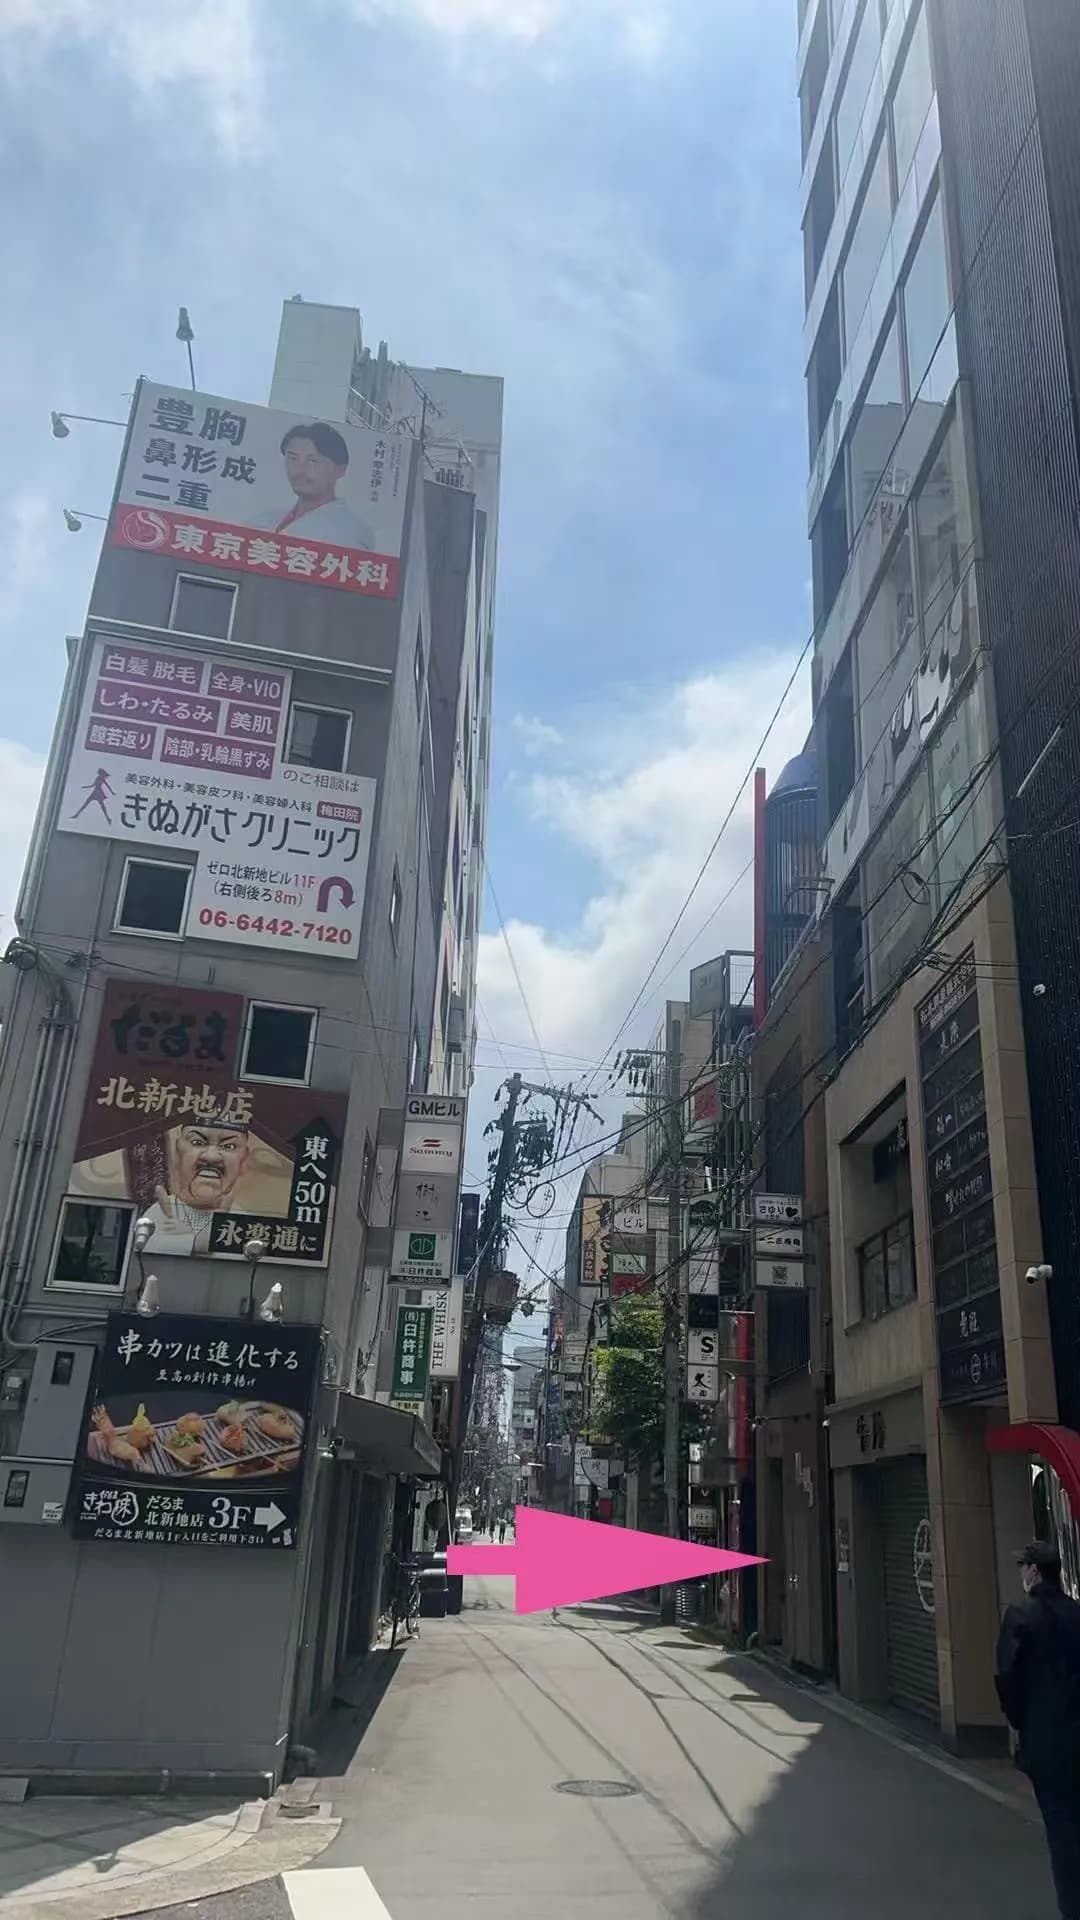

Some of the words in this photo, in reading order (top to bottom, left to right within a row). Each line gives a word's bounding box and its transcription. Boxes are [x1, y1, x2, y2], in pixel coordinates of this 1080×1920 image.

[149, 397, 247, 446] 豊胸
[143, 438, 257, 484] 鼻形成
[135, 473, 211, 511] 二重
[171, 524, 389, 591] 東京美容外科
[105, 654, 149, 677] 白髪
[153, 661, 196, 684] 脱毛
[100, 688, 214, 723] しわ・たるみ
[230, 711, 273, 735] 美肌
[164, 737, 271, 771] 陰部・乳輪黒ずみ
[283, 769, 360, 793] のご相談は
[121, 794, 361, 862] きぬがさクリニック
[320, 804, 360, 822] 梅田院
[199, 908, 353, 945] 06-6442-7120
[97, 1076, 254, 1124] 北新地店
[408, 1100, 461, 1117] GMビル
[216, 1219, 317, 1252] 永楽通に
[117, 1329, 299, 1370] 串カツは進化する
[432, 1341, 444, 1369] THE
[144, 1511, 204, 1528] 北新地店
[146, 1495, 185, 1511] だるま
[208, 1497, 252, 1530] 3F
